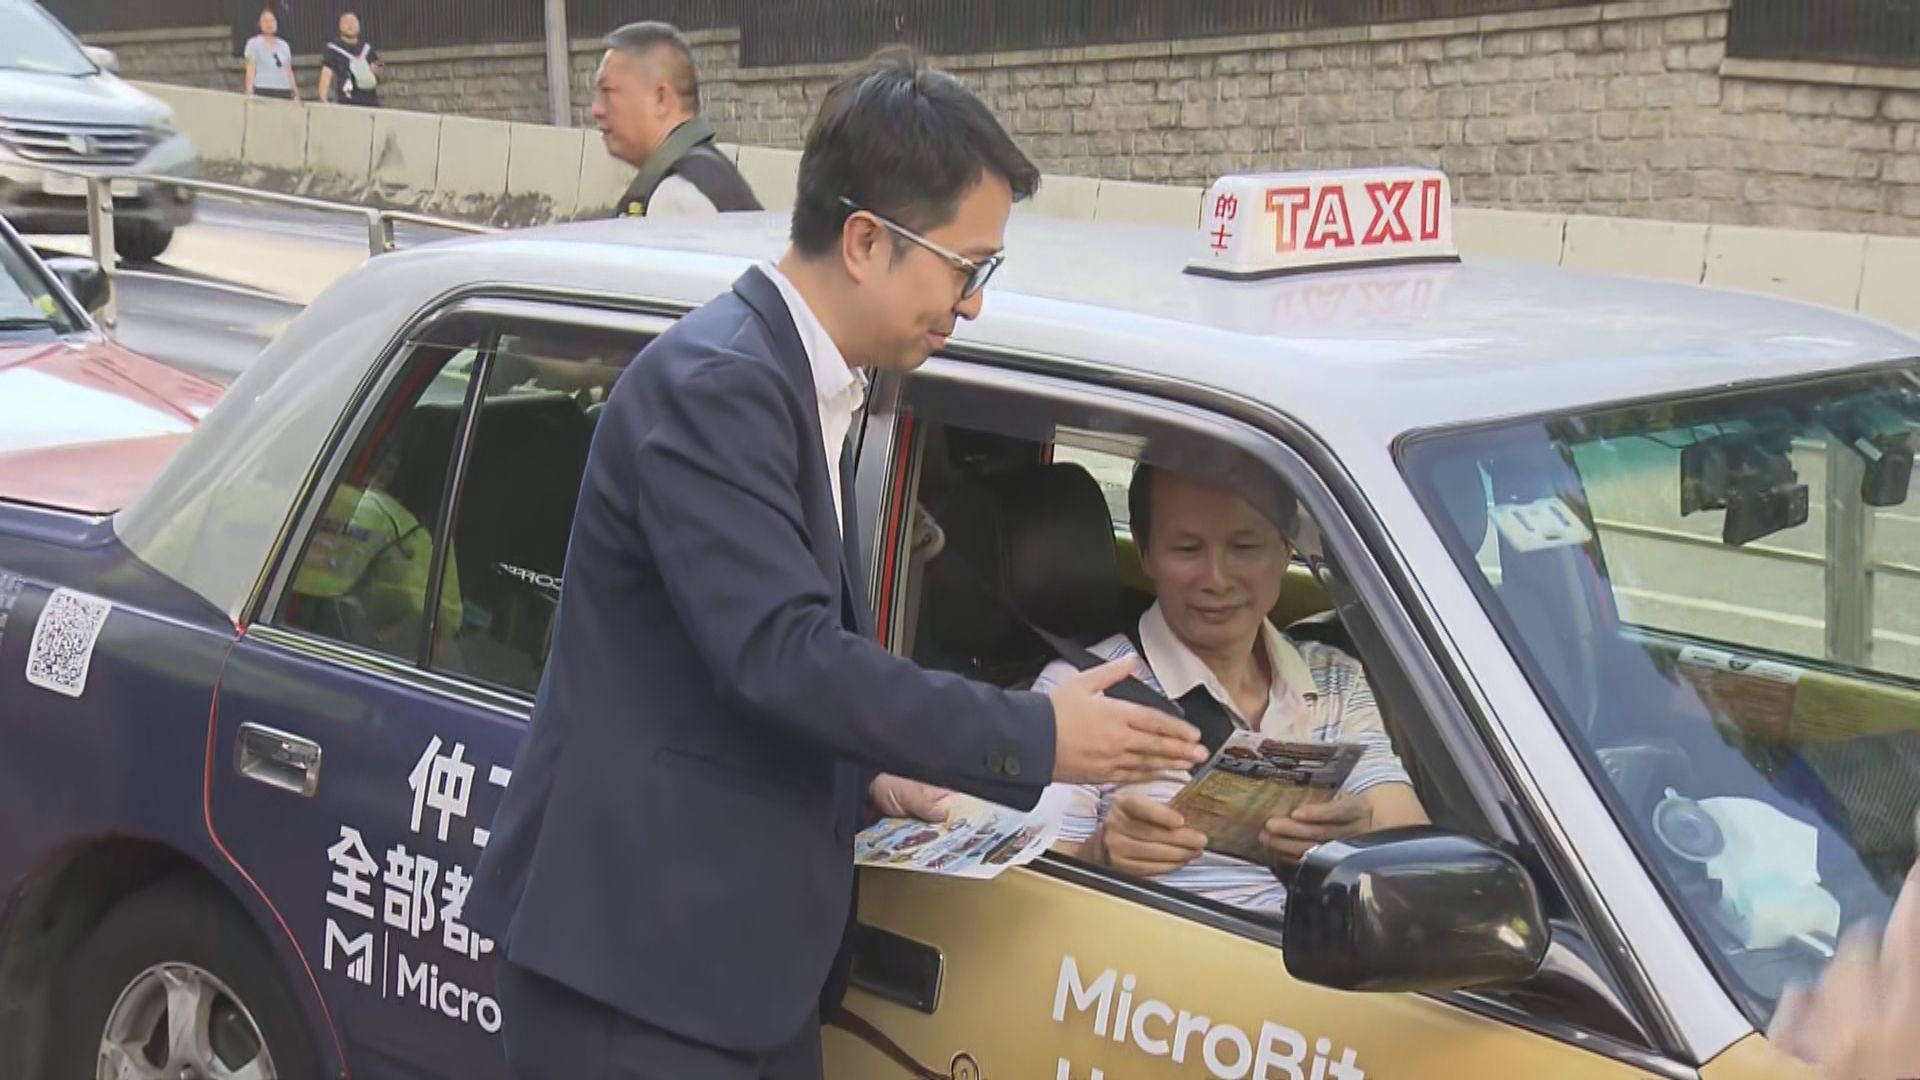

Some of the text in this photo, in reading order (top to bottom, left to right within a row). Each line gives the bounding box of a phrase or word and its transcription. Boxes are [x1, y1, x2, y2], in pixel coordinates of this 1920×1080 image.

[1210, 193, 1238, 250] 的士
[1266, 178, 1442, 252] TAXI
[396, 953, 503, 1034] Micro
[1052, 955, 1366, 1080] MicroBit
